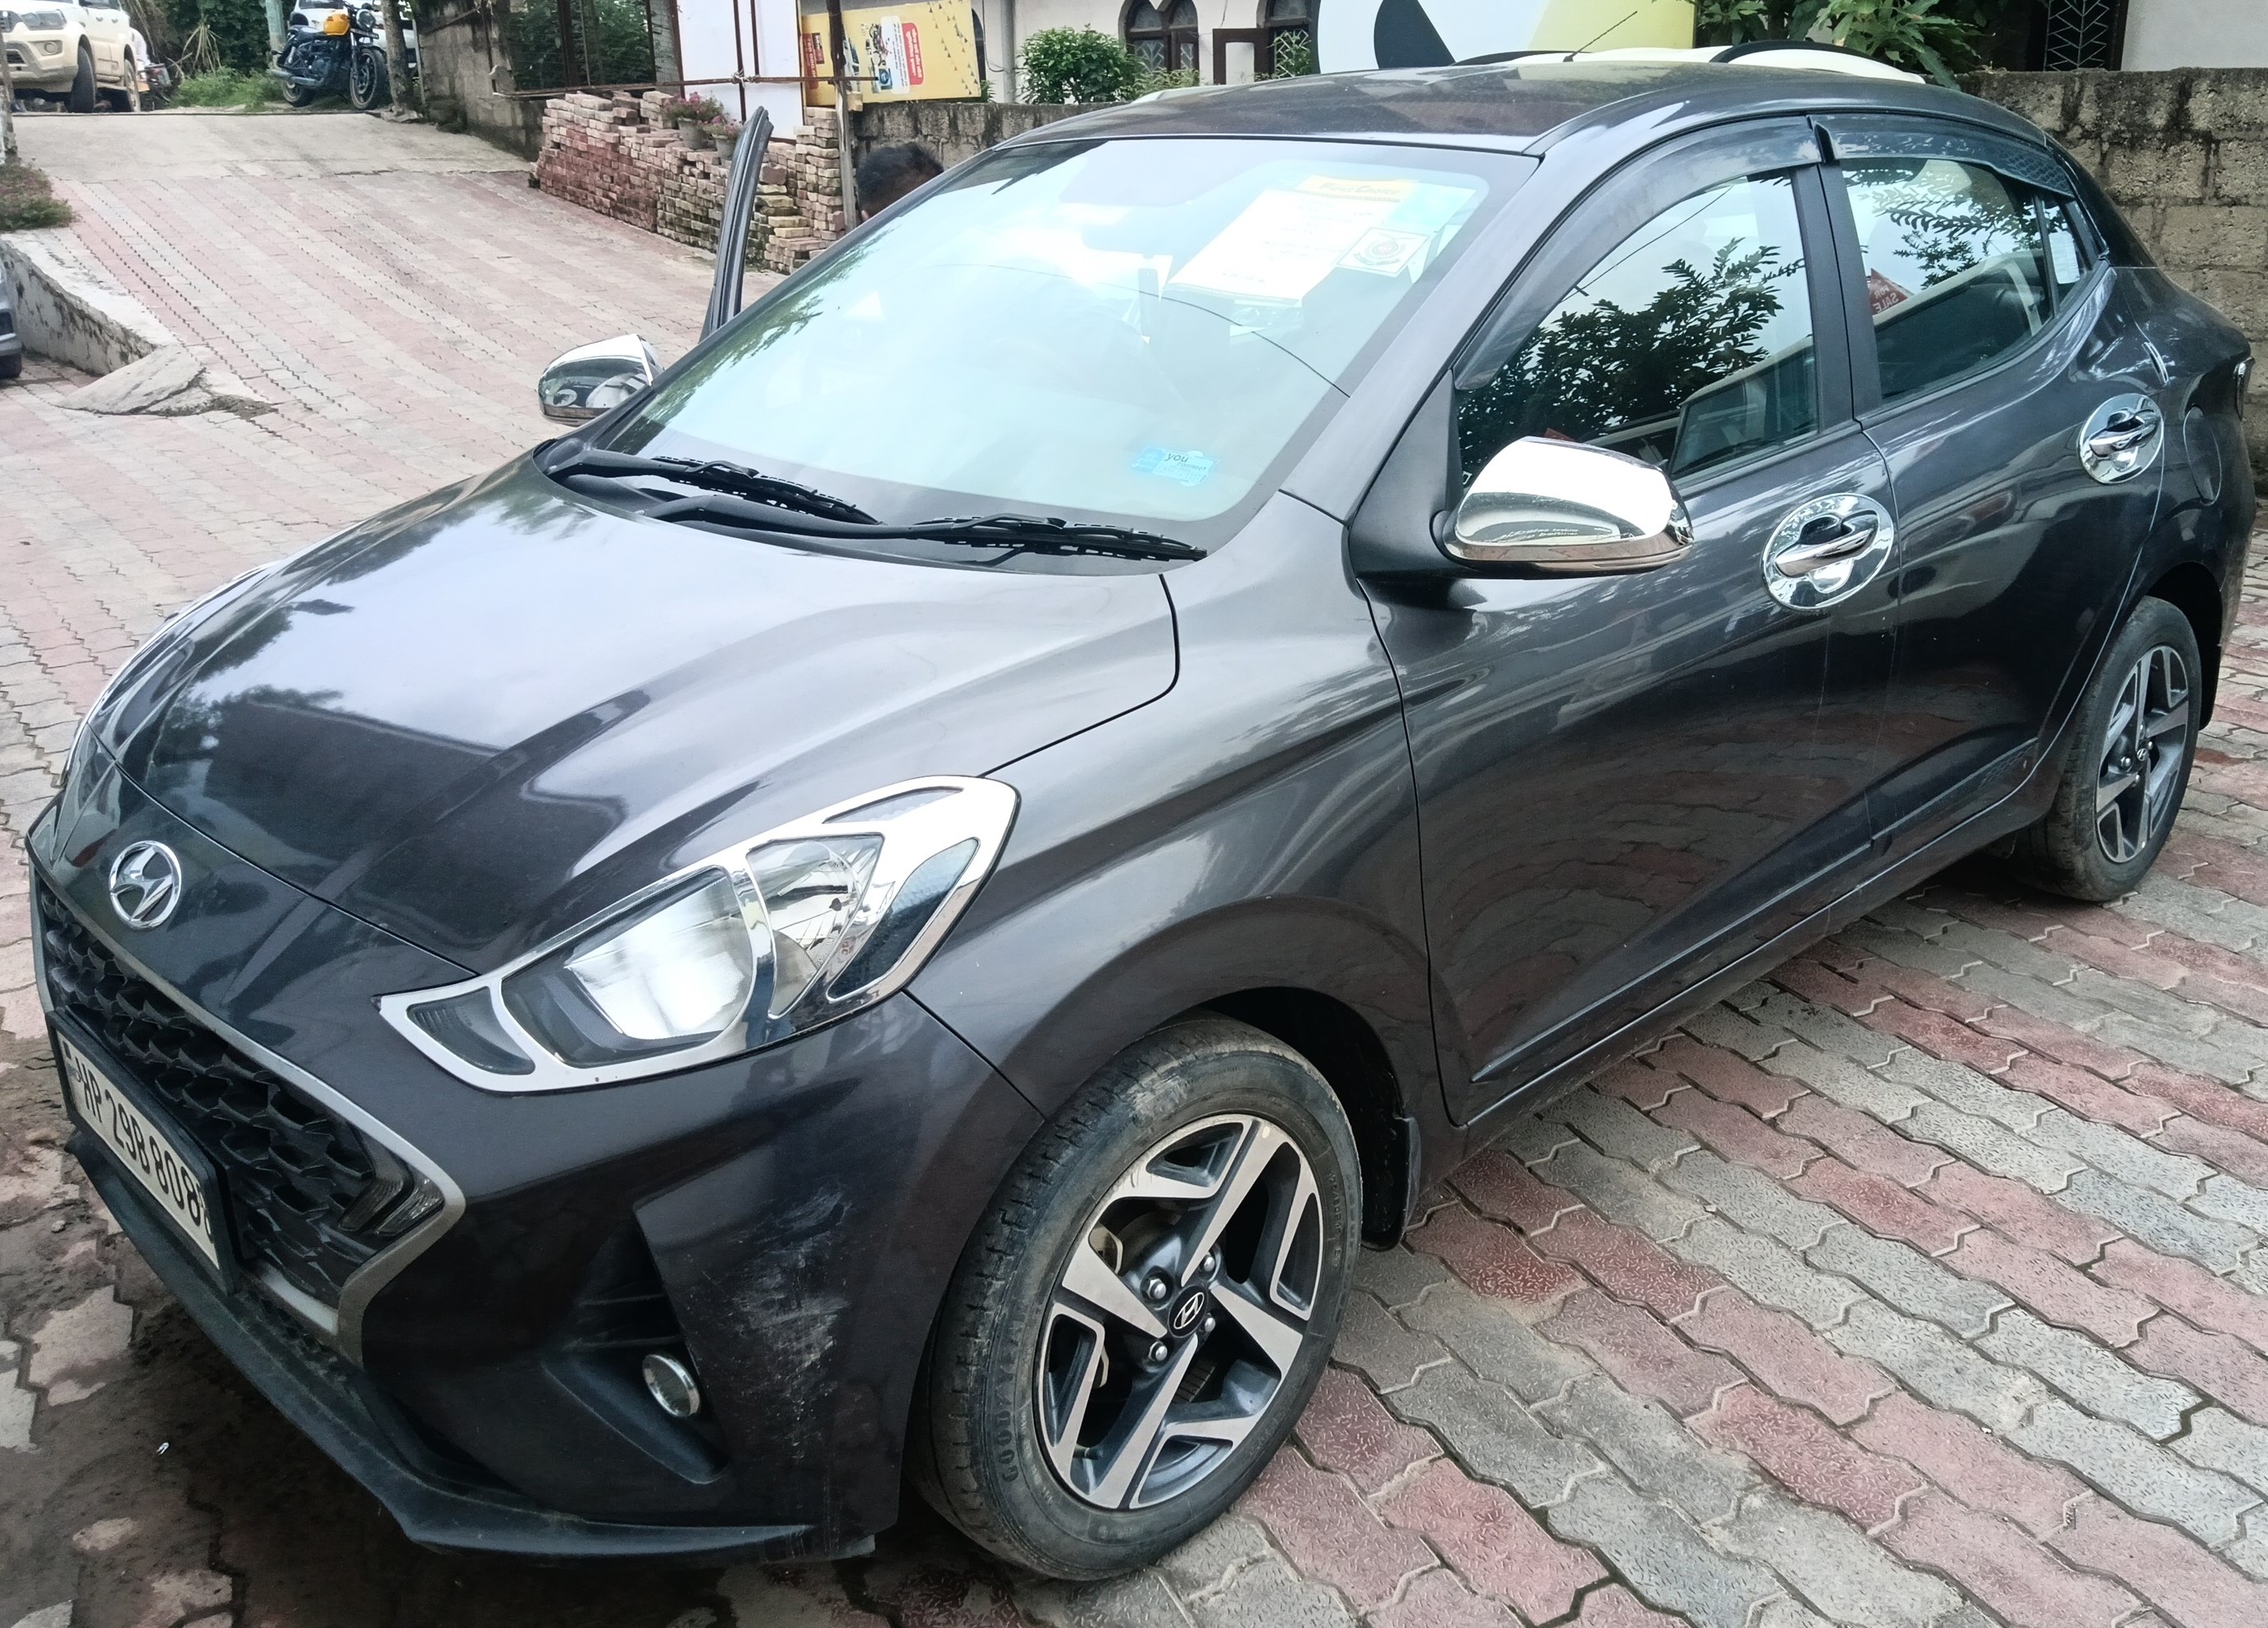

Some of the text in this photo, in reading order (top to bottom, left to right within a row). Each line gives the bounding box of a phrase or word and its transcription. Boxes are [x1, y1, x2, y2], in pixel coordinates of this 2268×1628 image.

[1164, 453, 1189, 463] you
[75, 1057, 102, 1124] HP
[105, 1089, 150, 1174] 29B
